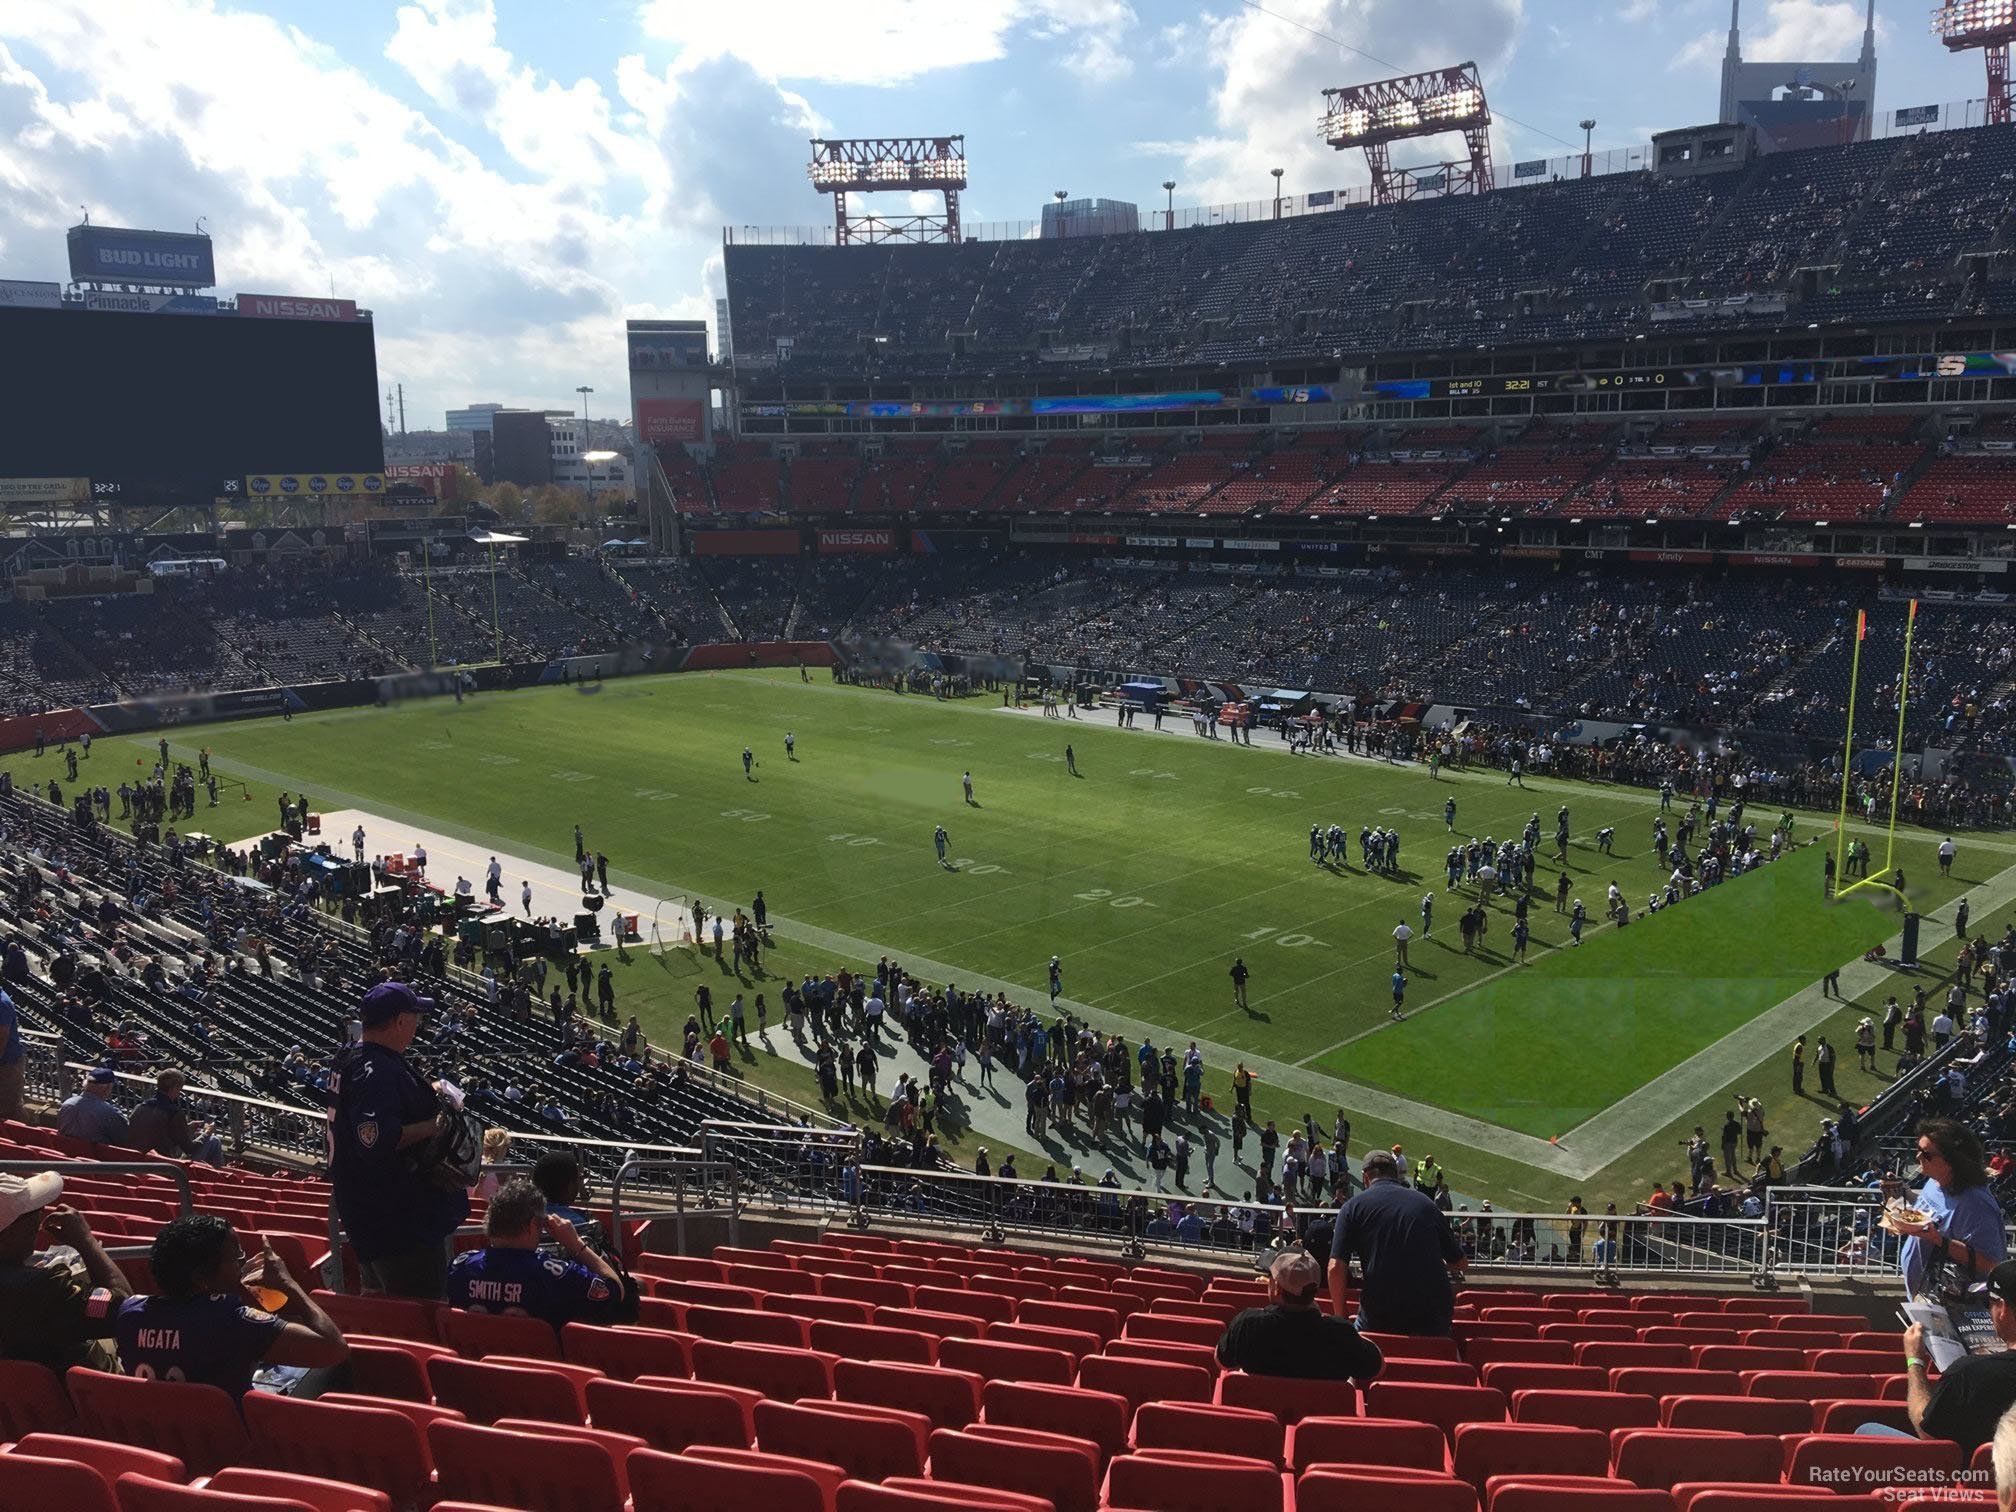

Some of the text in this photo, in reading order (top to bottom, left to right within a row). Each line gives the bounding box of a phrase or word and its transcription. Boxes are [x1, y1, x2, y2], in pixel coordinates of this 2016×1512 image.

[99, 248, 200, 269] BUD LIGHT
[87, 293, 150, 311] Pinnacle
[256, 300, 341, 318] NISSAN
[225, 480, 238, 491] 25
[822, 533, 889, 545] NISSAN
[1584, 550, 1604, 559] CMT
[1657, 552, 1684, 562] xfinity
[1846, 559, 1885, 567] GATORADE
[720, 808, 772, 823] 50
[828, 833, 878, 847] 40
[953, 858, 1002, 876] 30
[1073, 889, 1144, 908] 20
[1241, 926, 1315, 947] 10
[469, 1279, 522, 1303] SMITH SR
[1958, 1324, 1995, 1333] FAN EXPERI
[138, 1328, 180, 1350] NGATA
